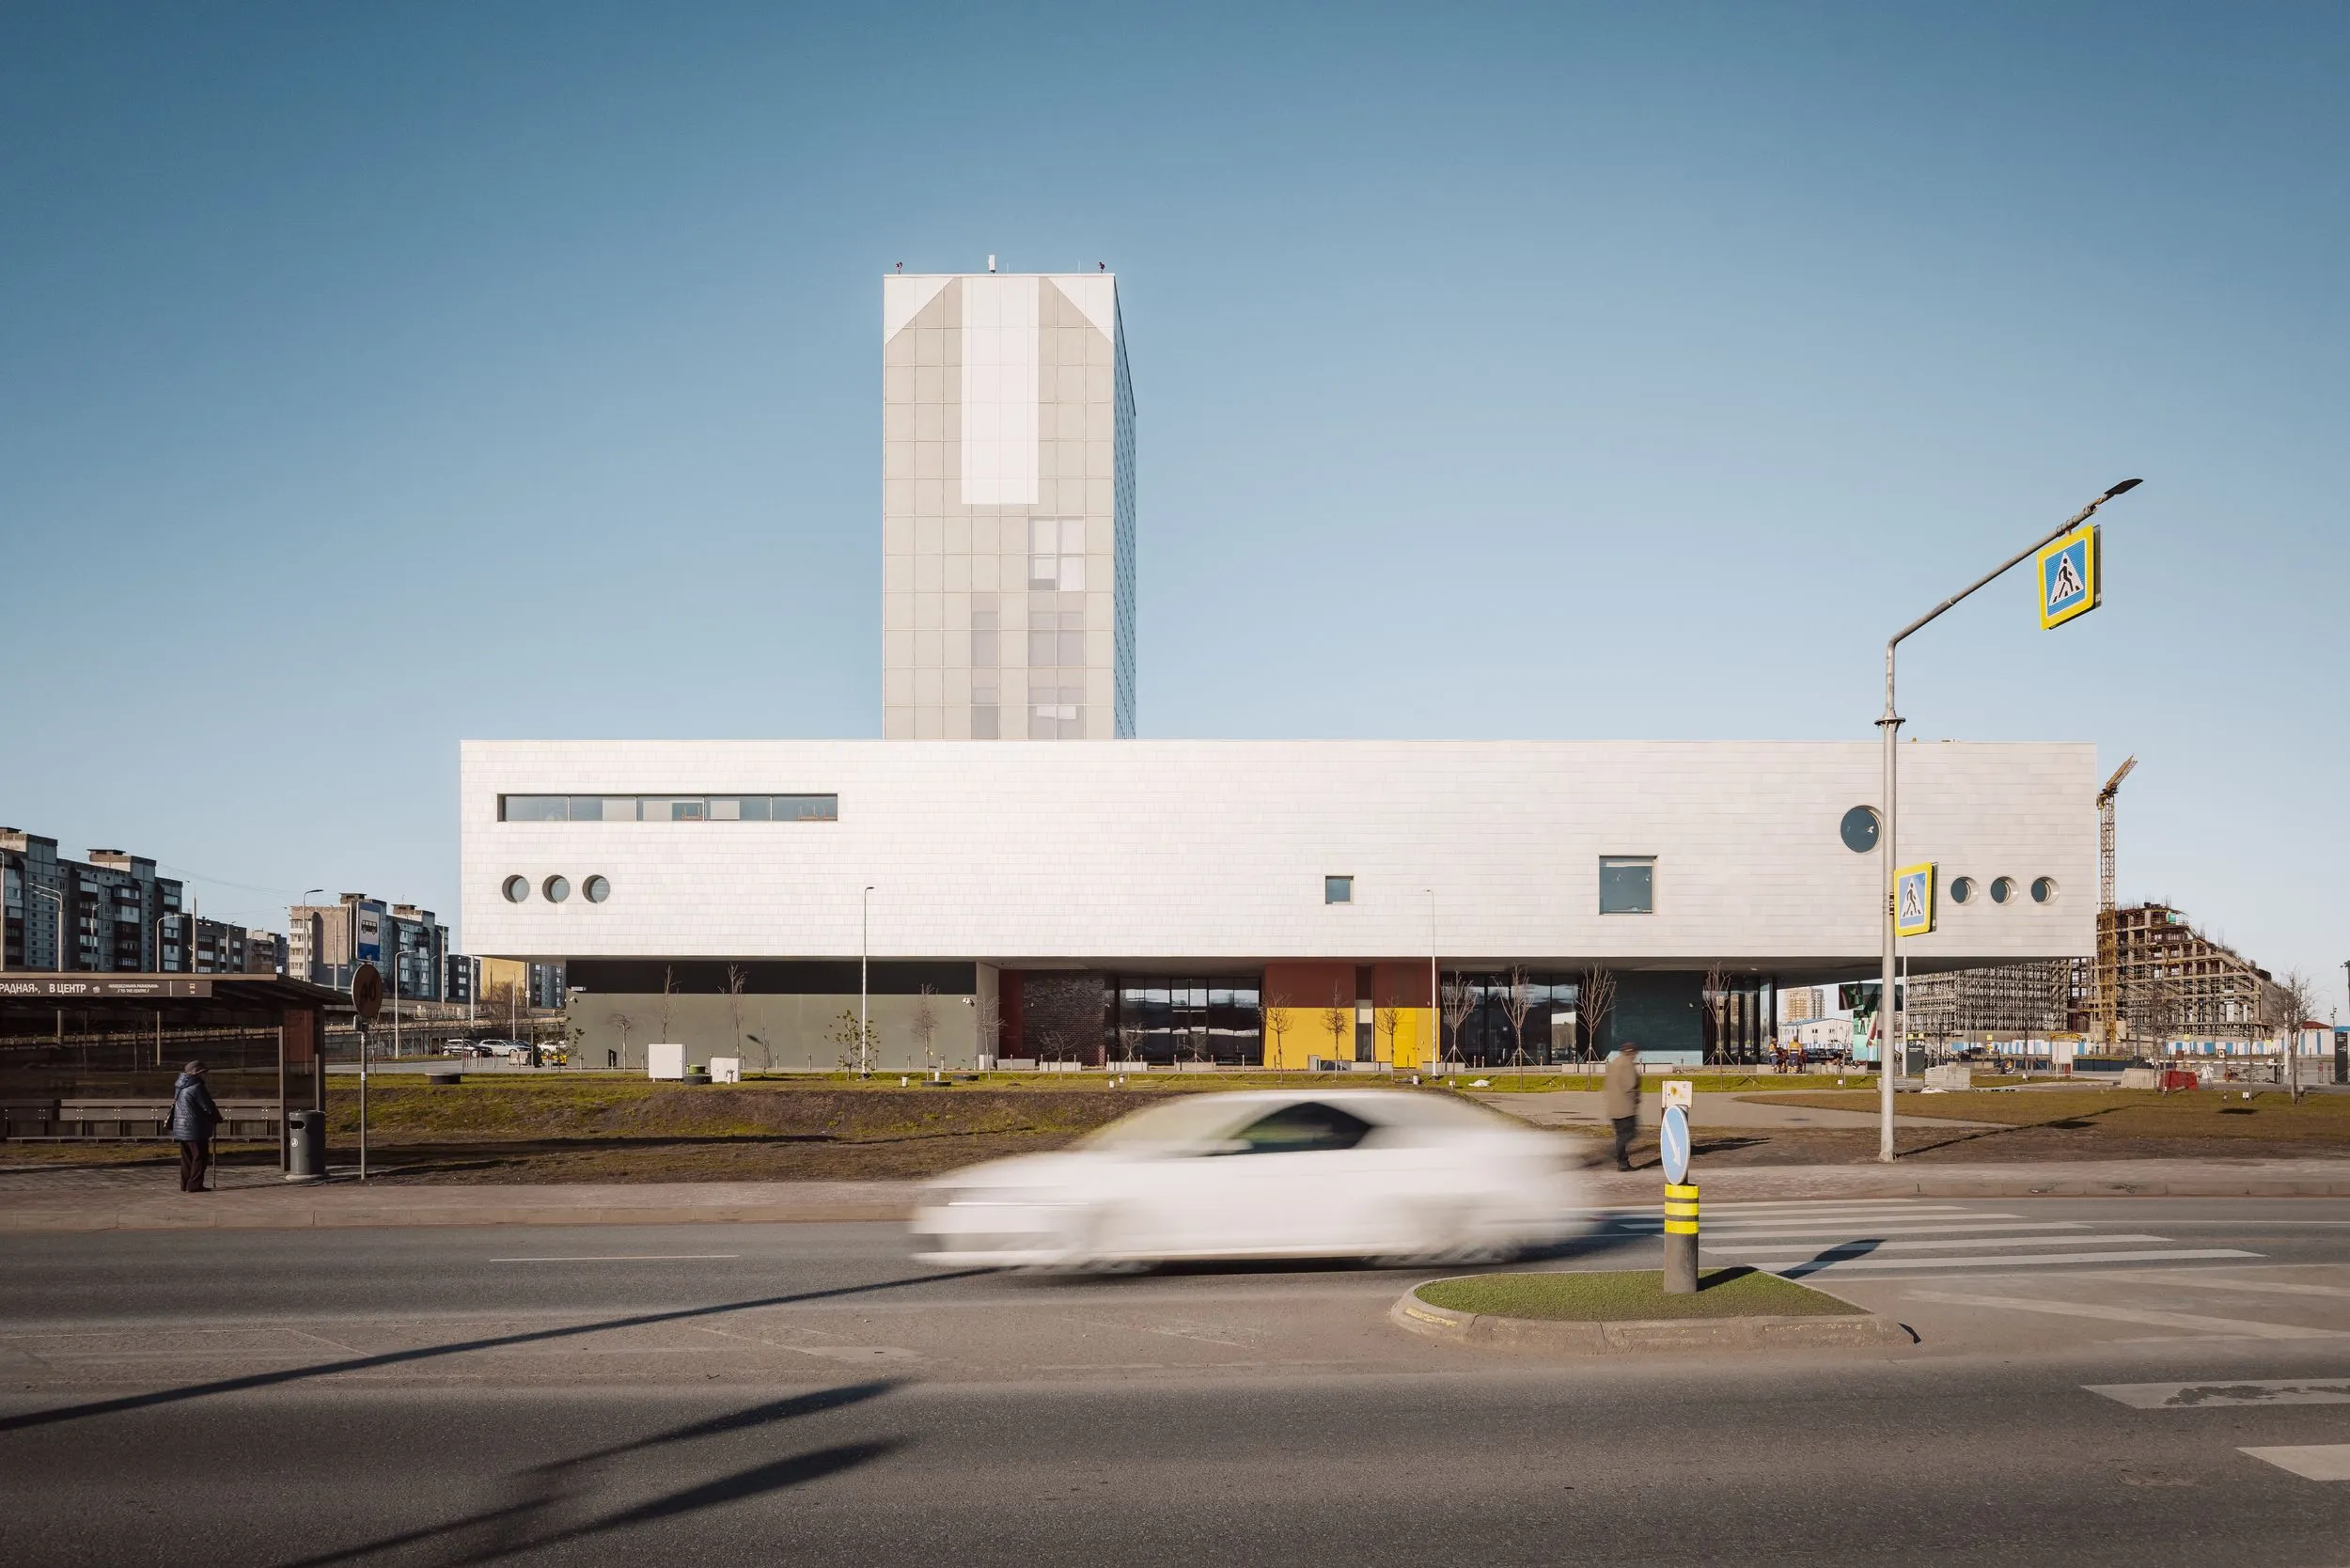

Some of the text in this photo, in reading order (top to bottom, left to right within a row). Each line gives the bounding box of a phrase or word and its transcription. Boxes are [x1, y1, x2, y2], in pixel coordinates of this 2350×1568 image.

[49, 983, 55, 993] В
[56, 983, 86, 995] ЦЕНТР
[360, 980, 376, 1001] 40
